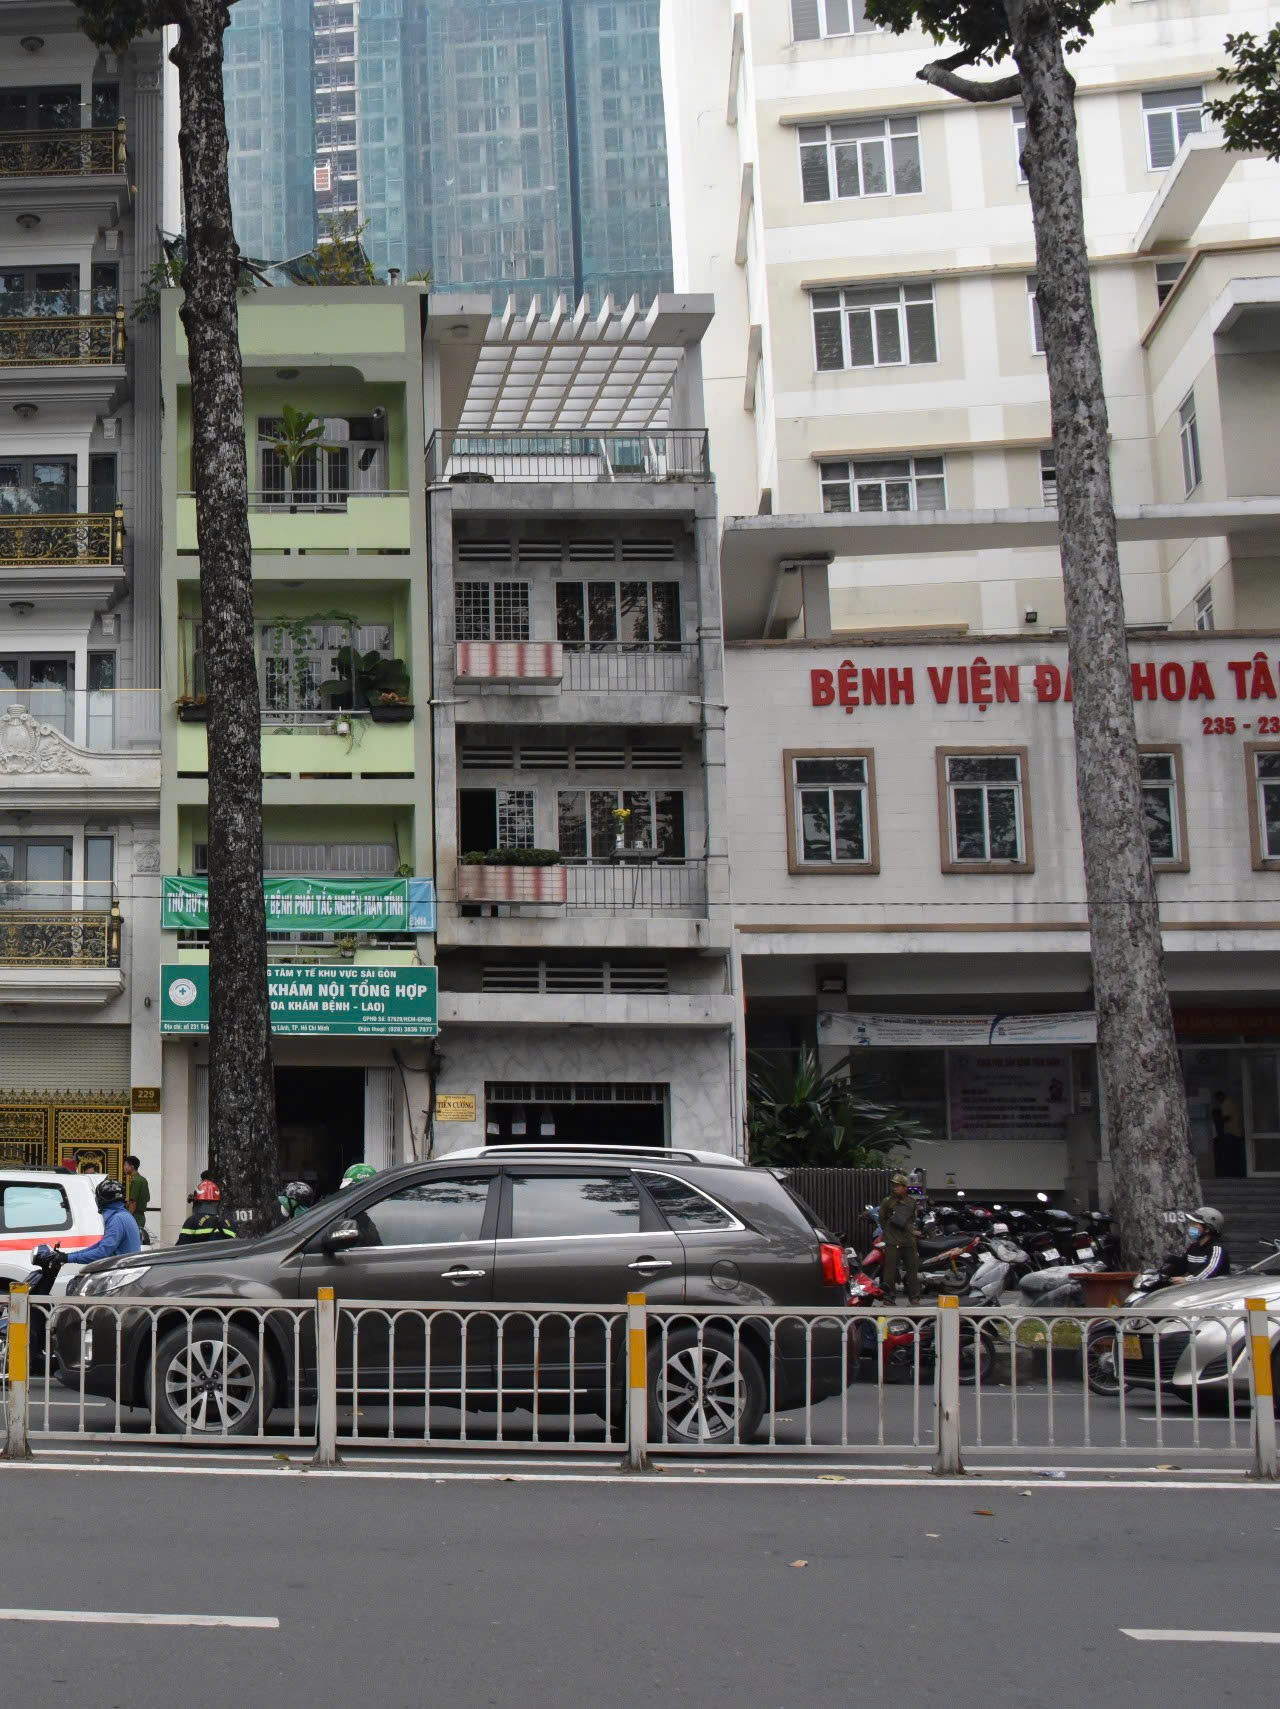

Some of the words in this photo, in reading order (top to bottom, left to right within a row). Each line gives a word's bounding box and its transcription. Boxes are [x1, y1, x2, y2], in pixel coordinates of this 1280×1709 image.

[810, 659, 915, 715] BỆNH
[926, 656, 1020, 712] VIỆN
[1129, 660, 1216, 700] HOA
[1227, 651, 1280, 699] TÂ
[1201, 715, 1237, 736] 235
[270, 889, 293, 919] BỆNH
[294, 885, 314, 915] PHỔI
[364, 896, 382, 919] MẠN
[384, 891, 404, 916] TÍNH
[275, 969, 294, 978] TÂM
[296, 970, 303, 978] Y
[305, 967, 317, 978] TẾ
[318, 970, 337, 978] KHU
[339, 969, 358, 980] VỰC
[360, 968, 375, 979] SÀI
[377, 968, 397, 979] GÒN
[268, 981, 313, 998] KHÁM
[318, 981, 345, 999] NỘI
[349, 979, 390, 998] TỔNG
[395, 983, 428, 1000] HỢP
[288, 999, 319, 1011] KHÁM
[322, 1000, 350, 1013] BỆNH
[361, 1002, 385, 1013] LAO)
[138, 1090, 155, 1099] 229
[235, 1209, 253, 1222] 101
[1162, 1210, 1186, 1223] 103
